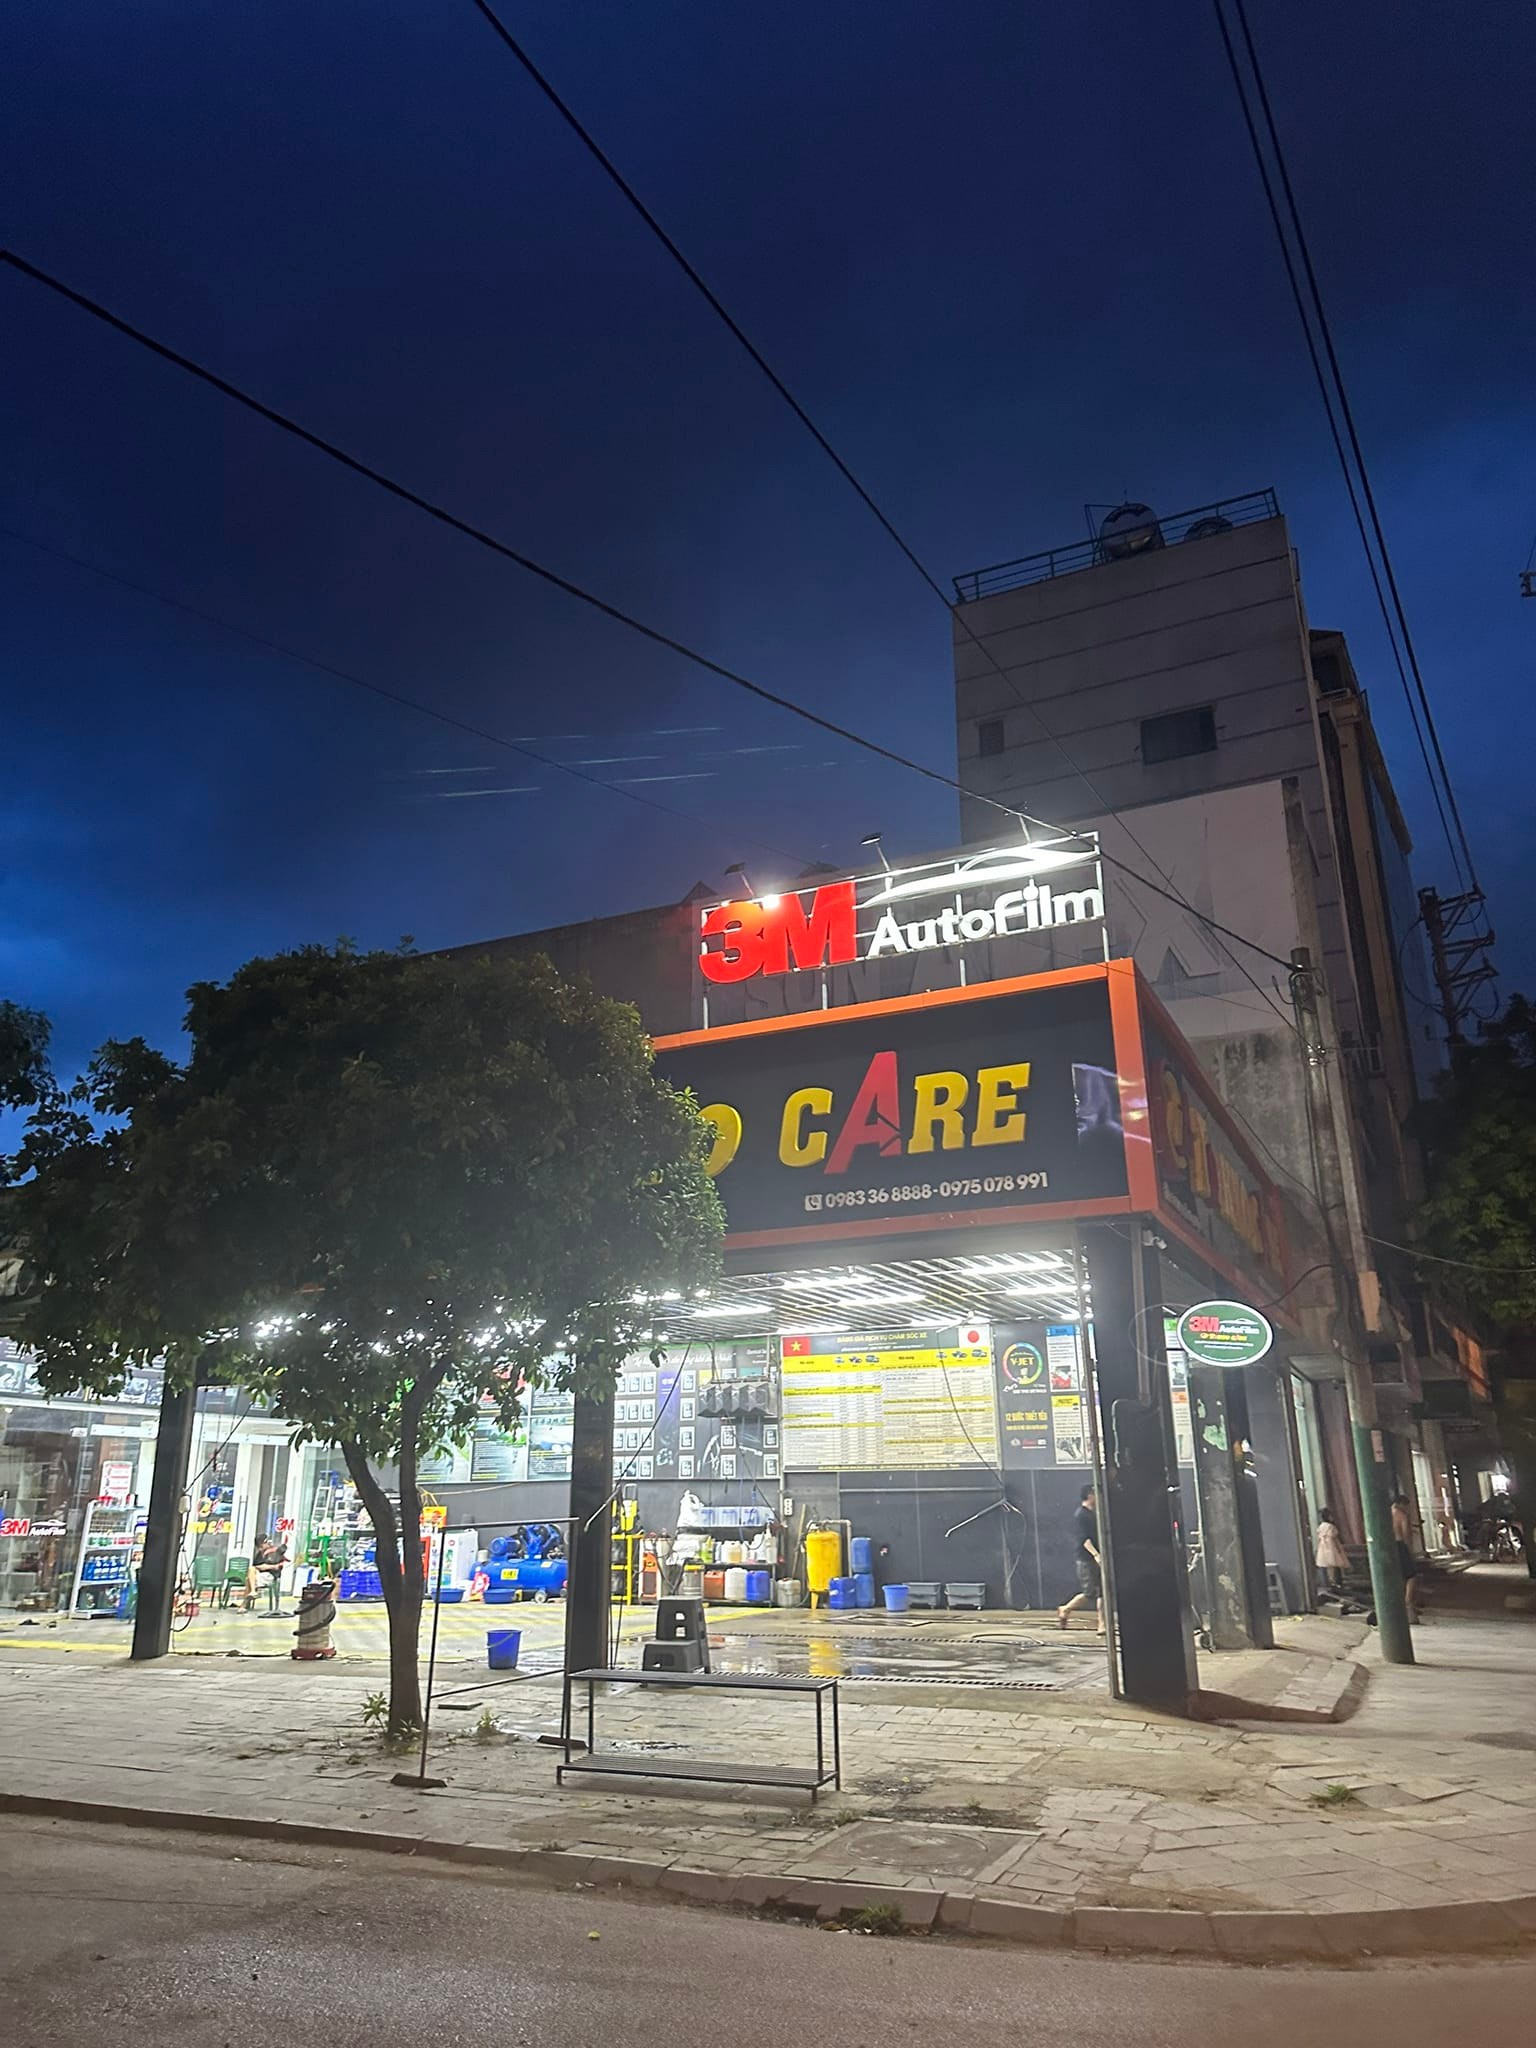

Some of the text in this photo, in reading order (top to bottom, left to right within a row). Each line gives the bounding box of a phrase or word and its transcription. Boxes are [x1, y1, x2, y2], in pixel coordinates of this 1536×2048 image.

[699, 882, 857, 984] 3M
[867, 885, 1105, 957] AutoFilm
[778, 1050, 1031, 1175] CARE
[825, 1191, 865, 1208] 0983
[868, 1188, 889, 1204] 36
[984, 1176, 1015, 1193] 078
[1016, 1172, 1048, 1190] 991
[1189, 1316, 1219, 1332] 3M
[1, 1518, 30, 1536] 3M
[275, 1517, 295, 1532] 3M
